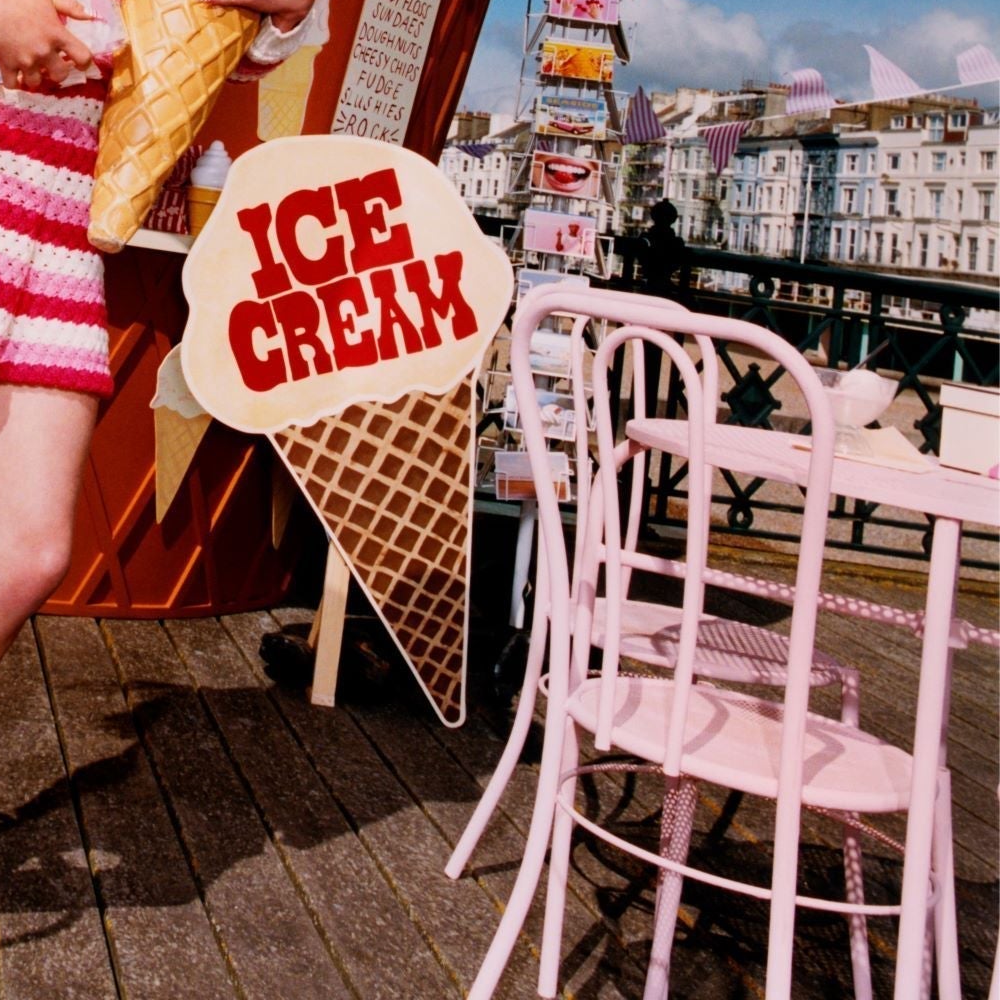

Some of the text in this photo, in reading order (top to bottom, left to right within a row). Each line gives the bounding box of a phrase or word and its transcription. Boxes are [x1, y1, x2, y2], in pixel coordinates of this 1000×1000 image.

[353, 43, 420, 83] CHEESY CHIPS
[357, 70, 404, 100] FUDGE
[340, 87, 405, 121] SLUSHIES
[344, 113, 390, 143] ROCK
[236, 167, 415, 299] ICE
[228, 250, 479, 393] CREAM
